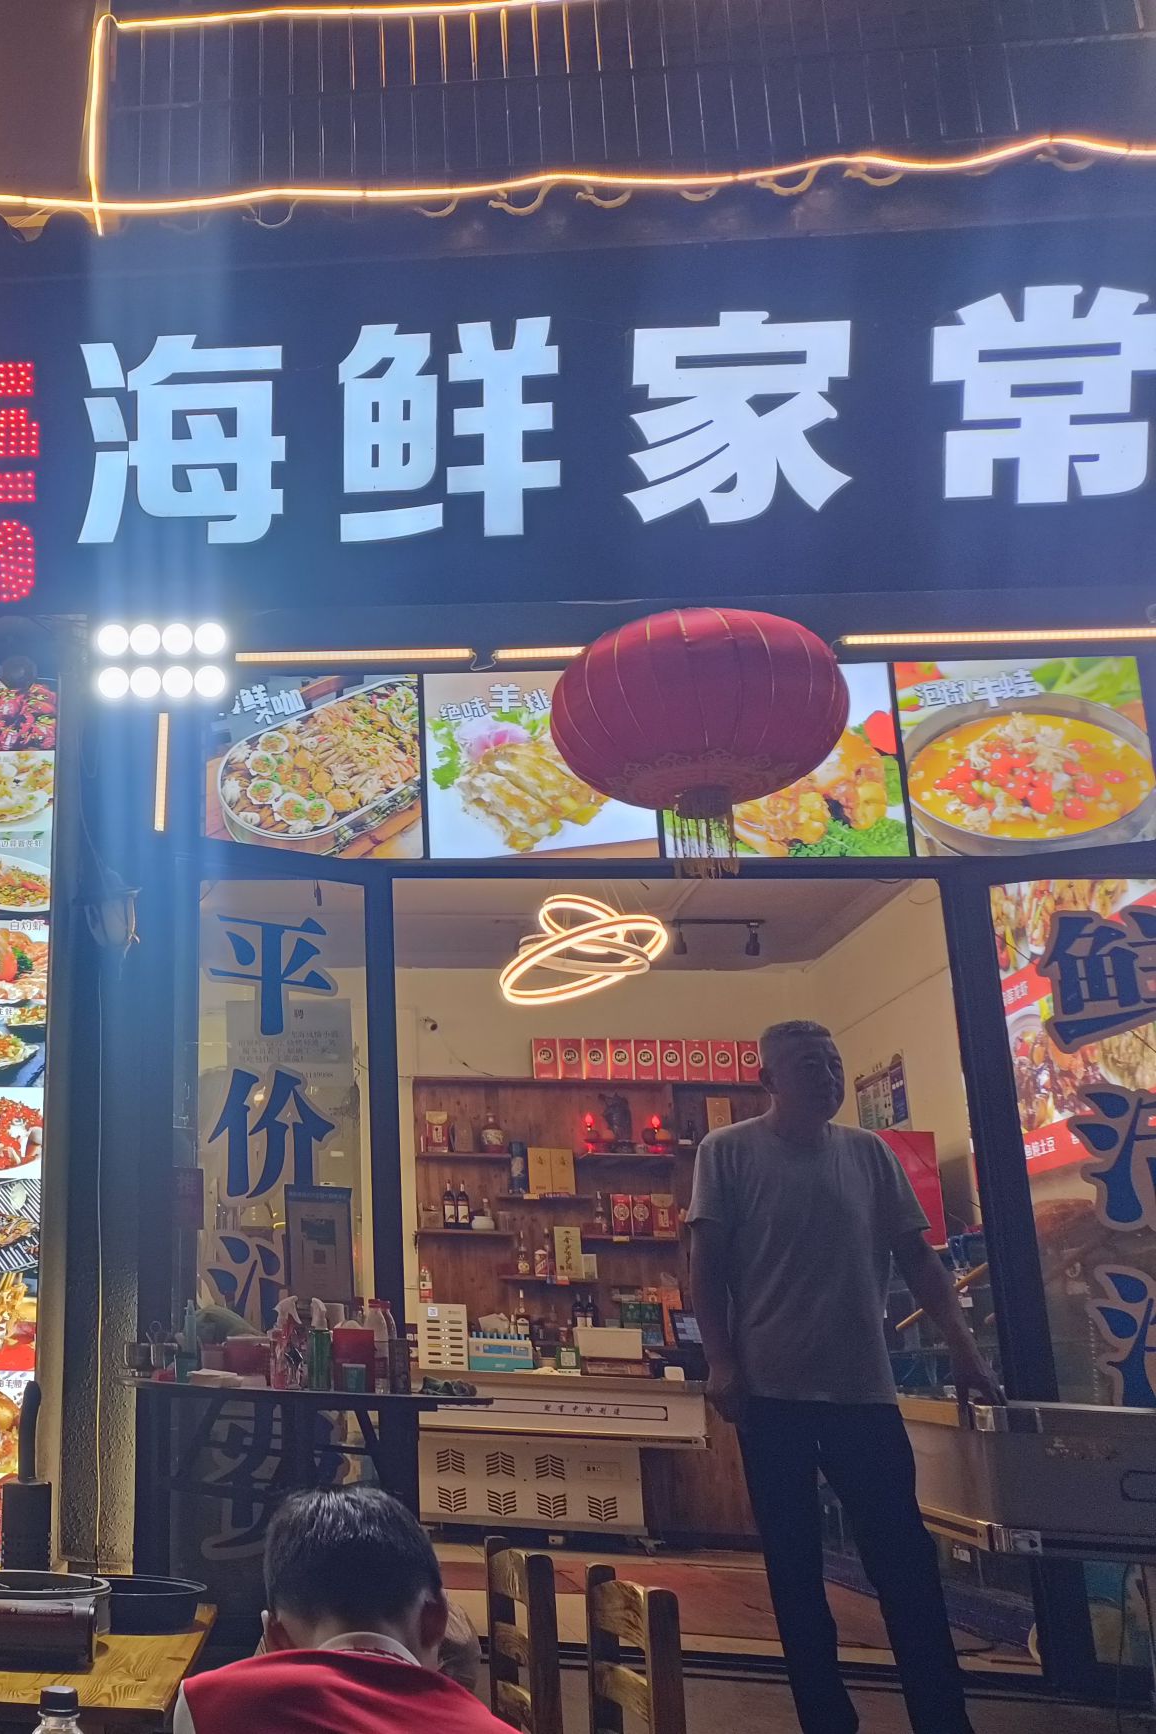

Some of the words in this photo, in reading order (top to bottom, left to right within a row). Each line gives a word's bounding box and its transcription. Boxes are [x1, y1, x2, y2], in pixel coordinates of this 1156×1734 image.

[439, 683, 552, 721] 绝味羊排
[915, 668, 1041, 708] 泡椒牛蛙
[10, 920, 44, 931] 白灼虾
